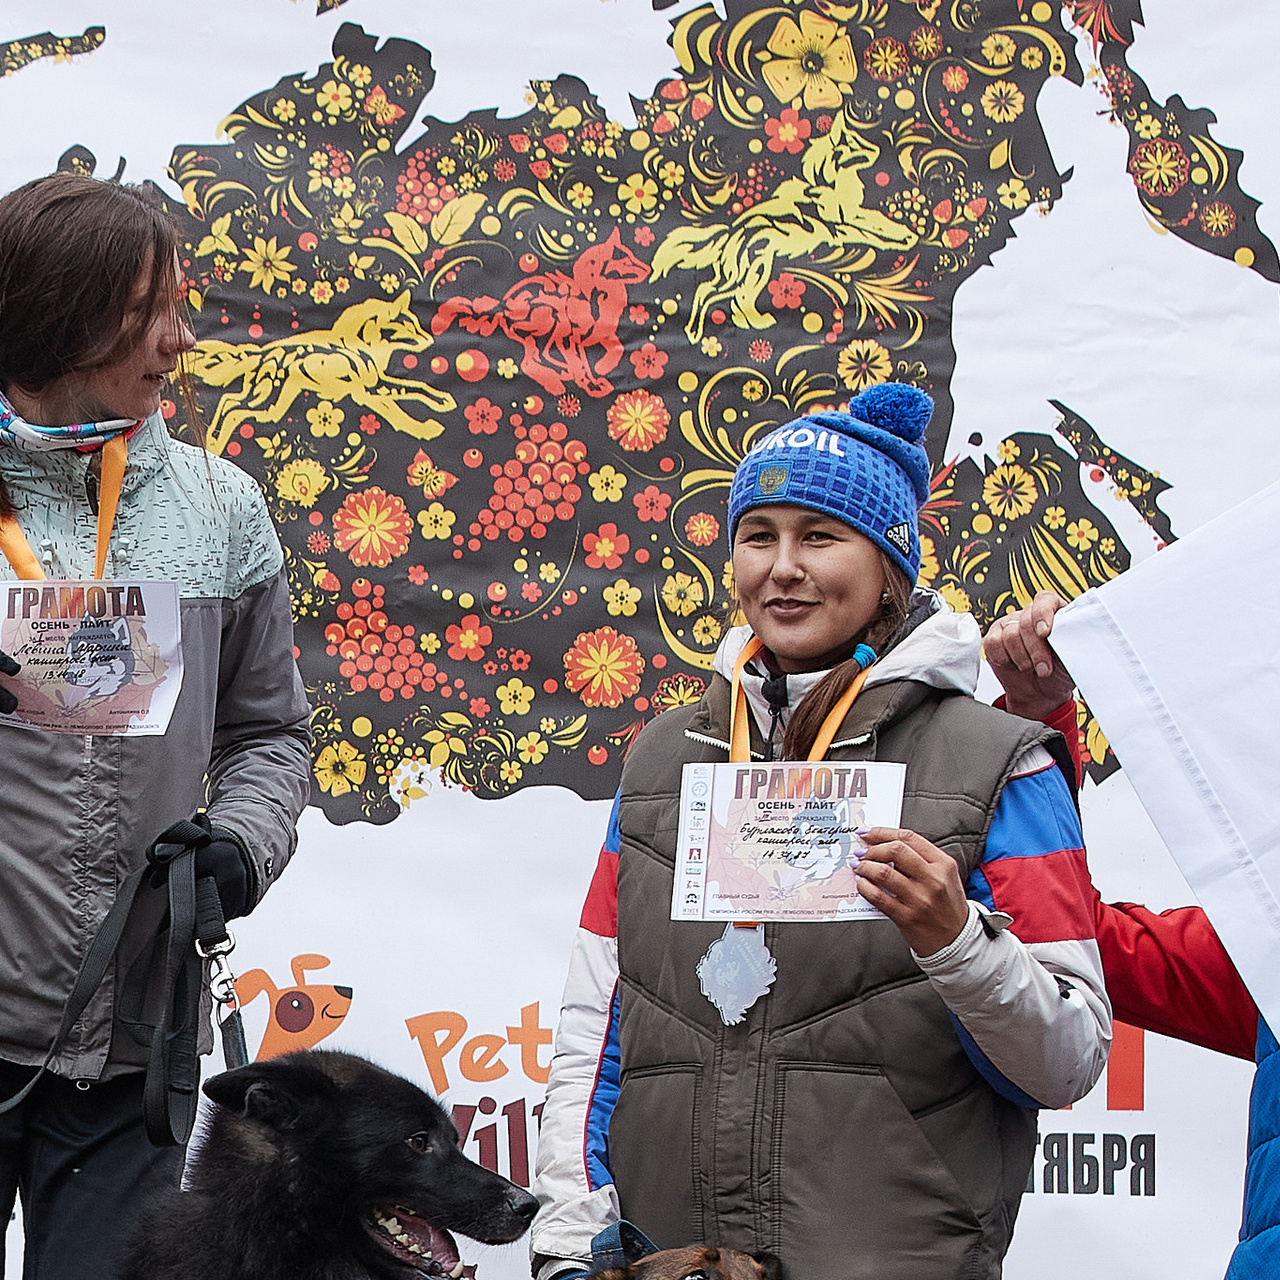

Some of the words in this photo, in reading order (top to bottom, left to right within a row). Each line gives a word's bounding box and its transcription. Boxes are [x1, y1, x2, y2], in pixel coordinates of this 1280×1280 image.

[7, 586, 146, 619] ГРАМОТА
[31, 621, 70, 629] ОСЕНЬ
[80, 619, 111, 629] ЛАЙТ
[68, 633, 116, 641] НАГРАЖДАЕТСЯ
[734, 768, 868, 800] ГРАМОТА
[758, 801, 795, 810] ОСЕНЬ
[804, 800, 835, 809] ЛАЙТ
[405, 1000, 553, 1096] Pet
